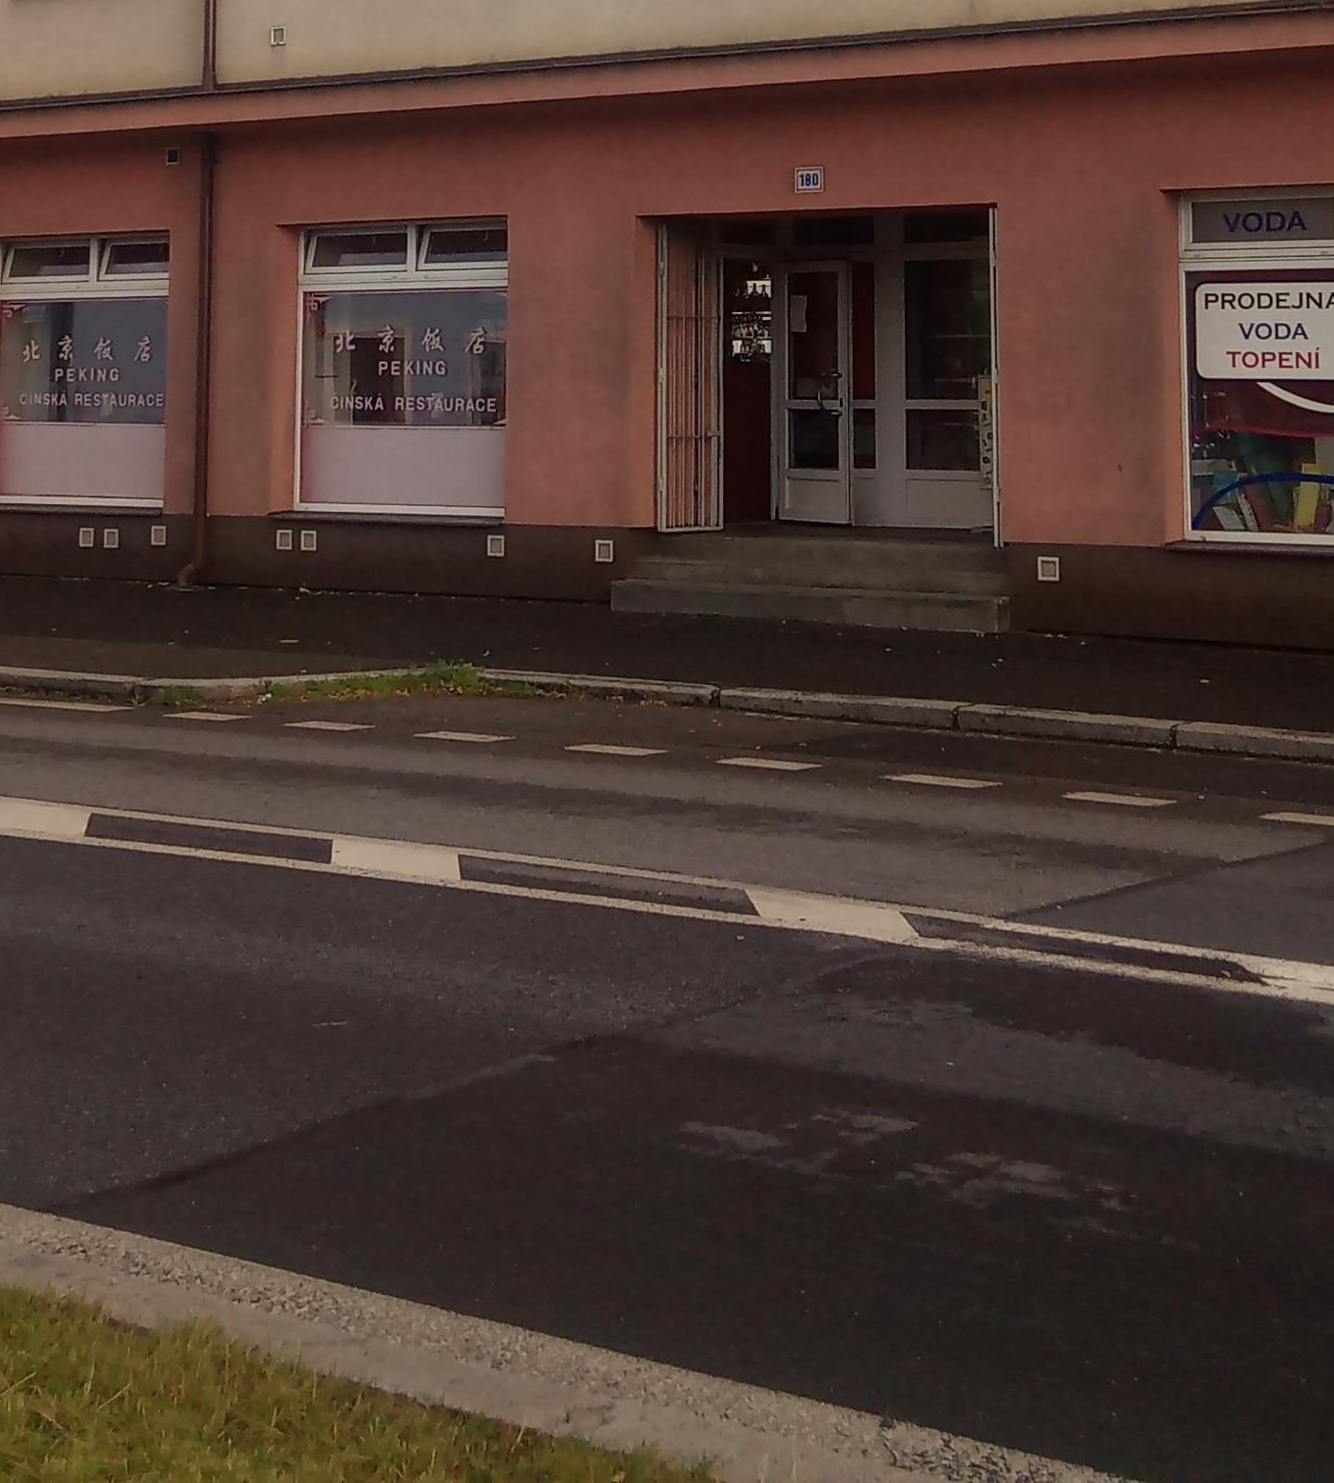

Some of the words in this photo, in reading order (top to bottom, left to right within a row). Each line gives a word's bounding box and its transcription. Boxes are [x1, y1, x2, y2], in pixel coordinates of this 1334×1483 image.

[799, 173, 819, 187] 180
[1222, 210, 1307, 233] VODA
[1238, 322, 1309, 341] VODA
[1226, 346, 1320, 369] TOPENÍ
[54, 368, 119, 382] PEKING
[378, 360, 448, 376] PEKING
[74, 393, 164, 407] RESTAURACE
[395, 396, 497, 412] RESTAURACE
